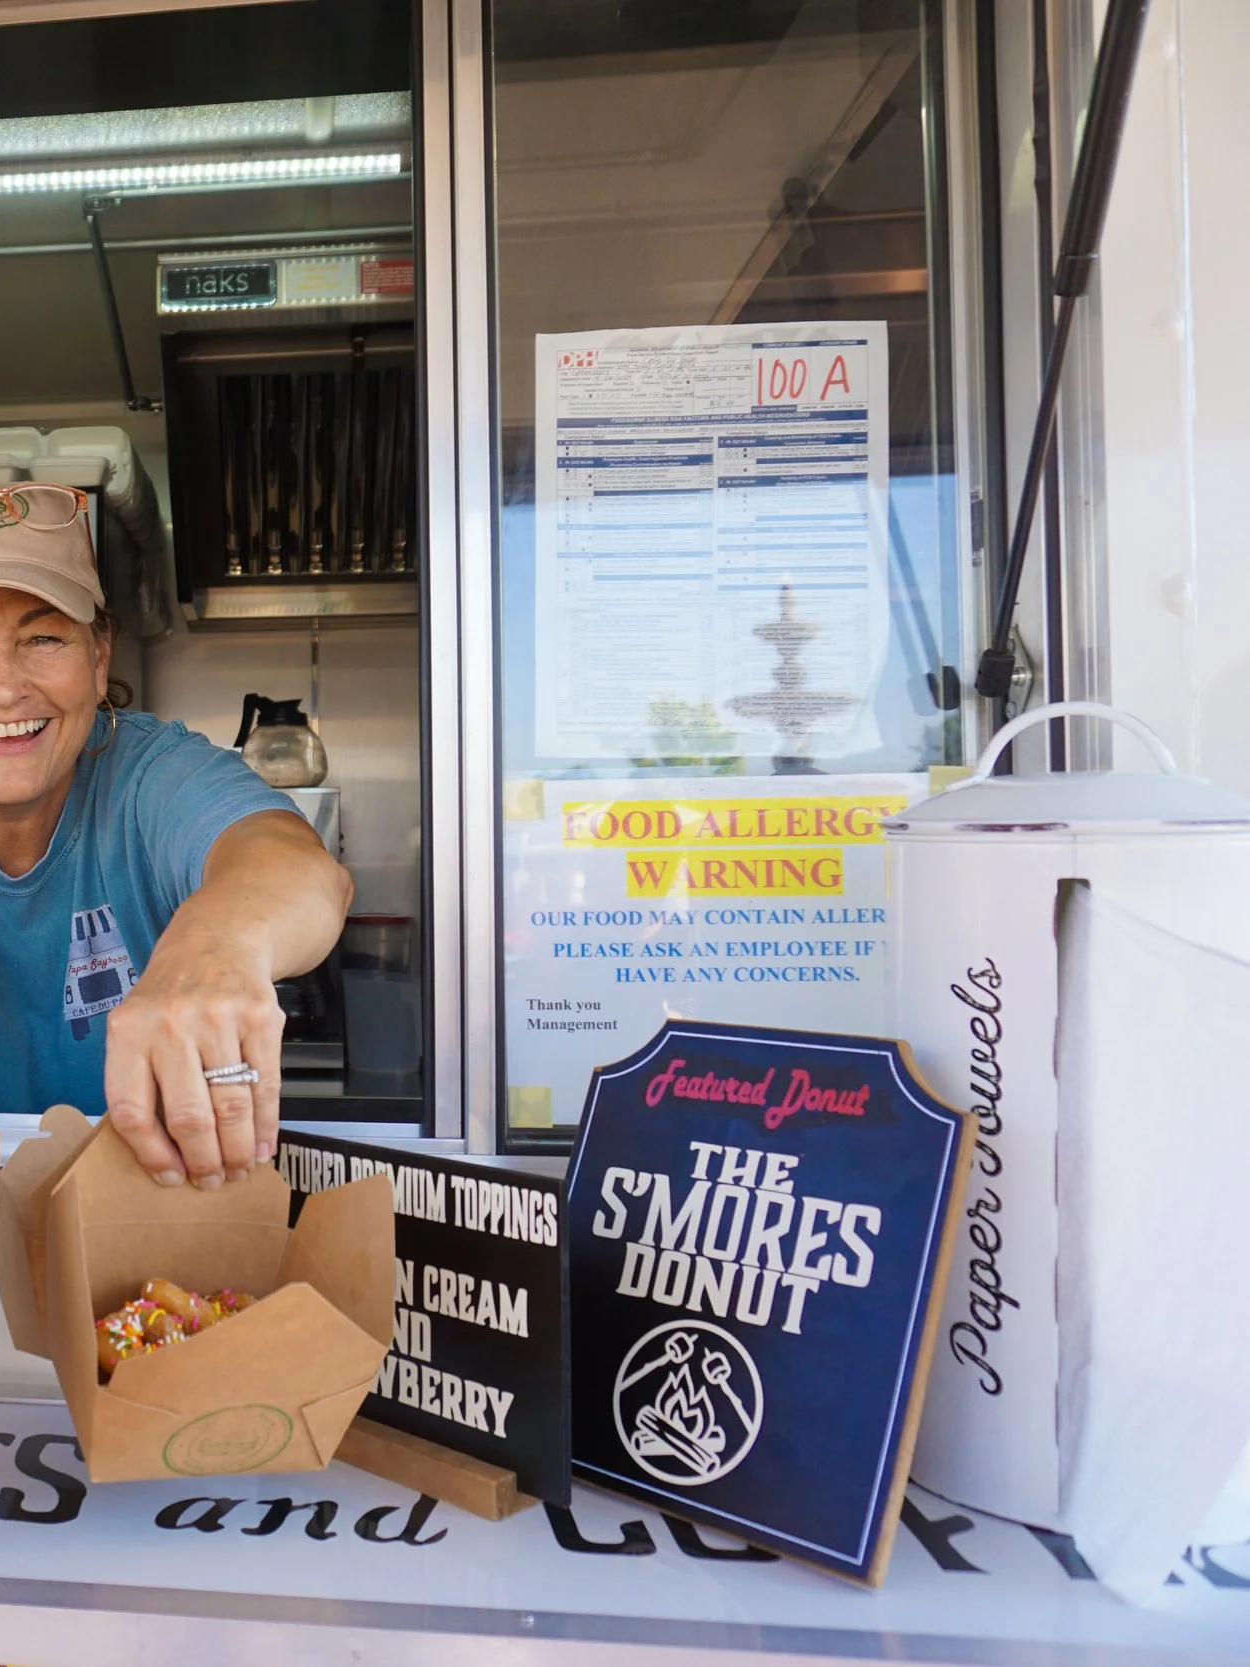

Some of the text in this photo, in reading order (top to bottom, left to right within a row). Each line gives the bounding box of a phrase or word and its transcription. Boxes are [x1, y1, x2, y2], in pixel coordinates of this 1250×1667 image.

[757, 355, 850, 405] 100 A
[563, 810, 682, 841] FOOD
[627, 857, 843, 890] WARNING
[531, 911, 576, 926] OUR
[583, 911, 642, 926] FOOD
[649, 911, 698, 926] MAY
[704, 908, 805, 925] CONTAIN
[553, 940, 876, 958] PLEASE ASK AN EMPLOYEE IF
[616, 966, 860, 983] HAVE ANY CONCERNS.
[72, 1003, 98, 1017] CAFE
[526, 999, 601, 1014] Thank you
[526, 1018, 618, 1033] Management
[645, 1058, 870, 1129] Featured Donut
[689, 1140, 799, 1195] THE
[274, 1143, 558, 1247] ATURED PMIUM TOPPINGS
[592, 1166, 881, 1288] S'MORES
[423, 1264, 529, 1339] CREAM
[615, 1241, 821, 1336] DONUT
[950, 1186, 1020, 1397] Paper
[154, 1493, 449, 1547] and
